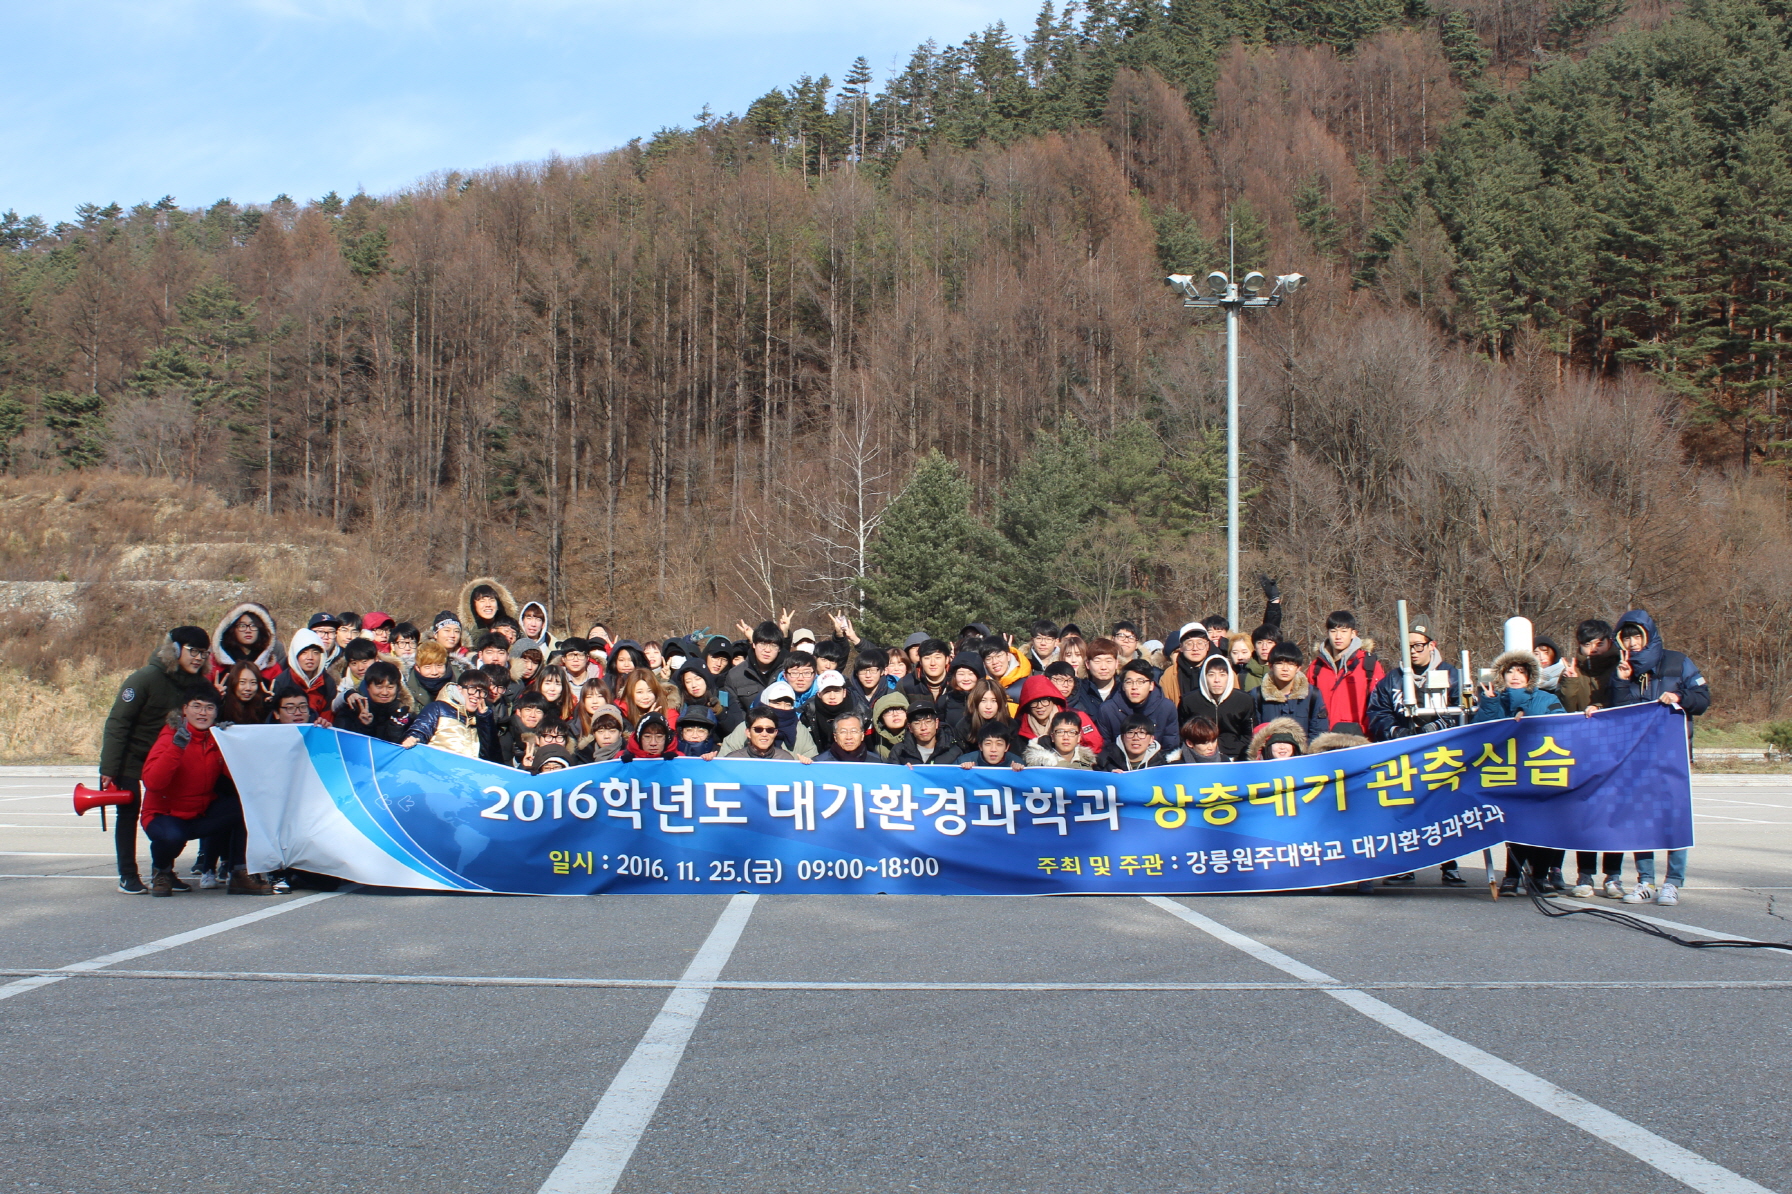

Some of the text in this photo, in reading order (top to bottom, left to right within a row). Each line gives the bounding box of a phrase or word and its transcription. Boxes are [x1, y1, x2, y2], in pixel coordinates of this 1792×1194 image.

[479, 735, 1576, 836] 2016학년도 대기환경과학과 상층대기 관측실습
[548, 850, 594, 875] 일시
[616, 854, 669, 881] 2016.
[676, 861, 700, 882] 11.
[708, 857, 783, 884] 25.(금)
[797, 857, 939, 880] 09:00~18:00
[1037, 856, 1082, 875] 주최
[1089, 855, 1111, 877] 및
[1119, 853, 1164, 876] 주관
[1186, 839, 1346, 874] 강릉원주대학교
[1351, 803, 1506, 859] 대기환경과학과
